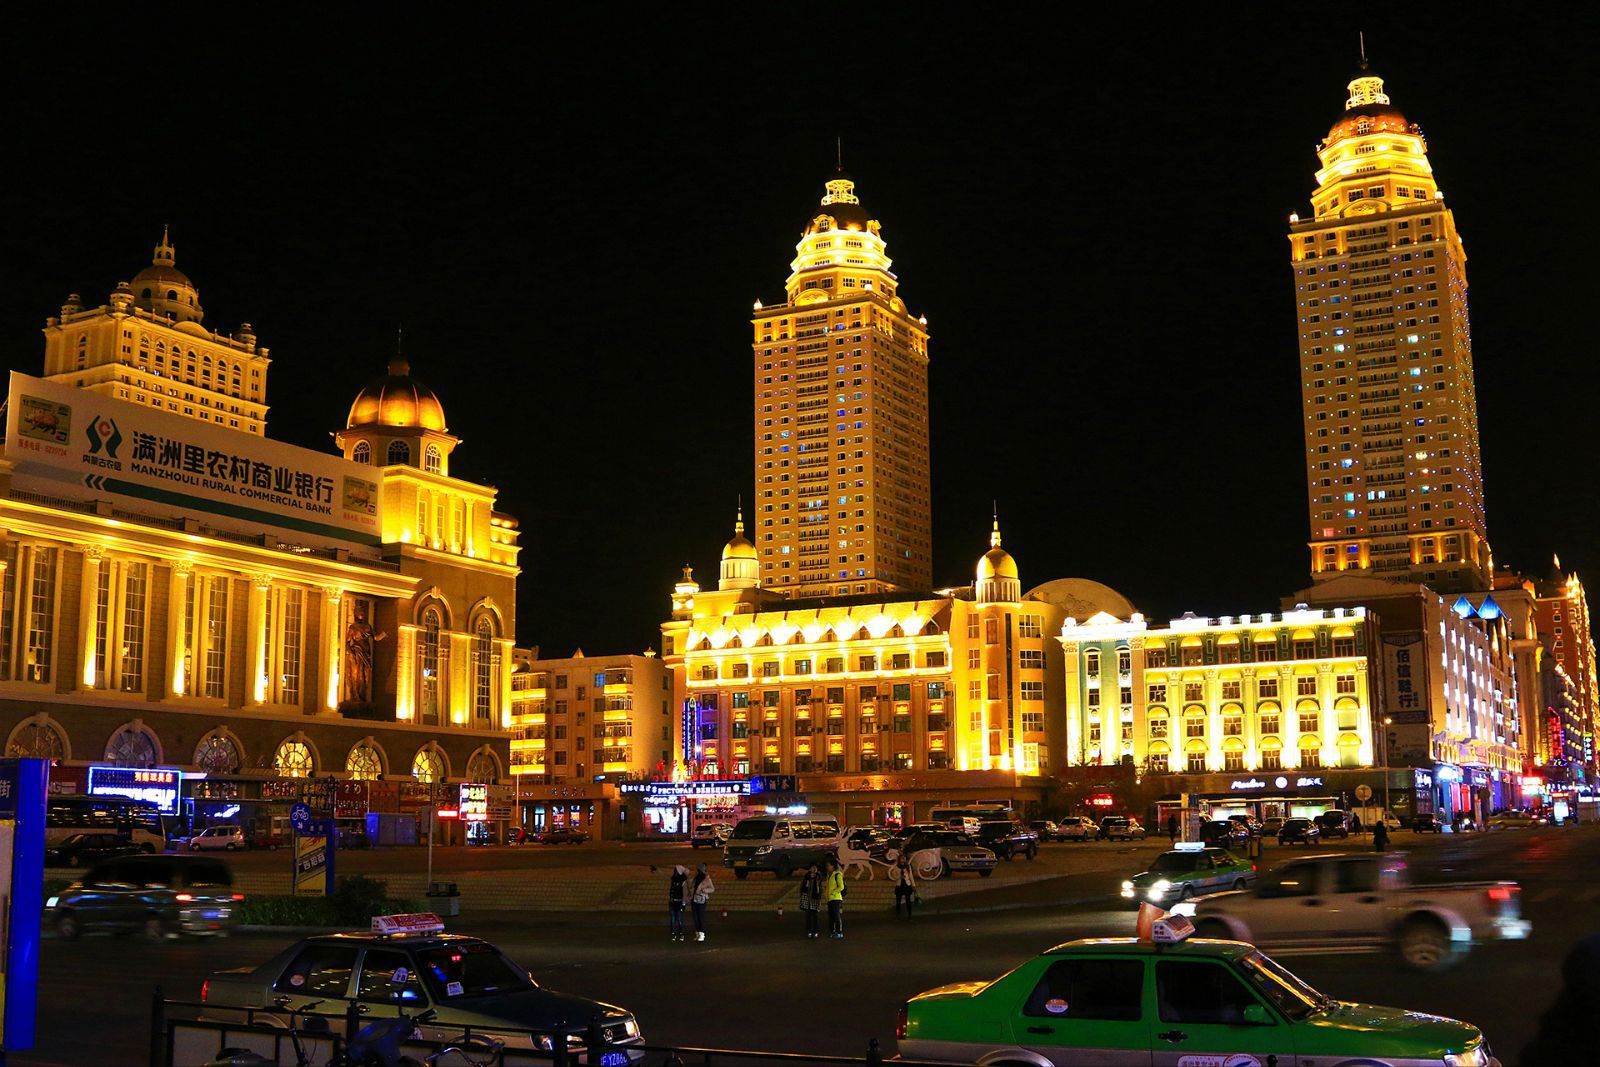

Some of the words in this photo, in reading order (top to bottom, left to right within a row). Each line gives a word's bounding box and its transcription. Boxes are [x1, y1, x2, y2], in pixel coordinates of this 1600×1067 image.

[131, 431, 334, 503] 满洲里农村商业银行
[131, 462, 199, 486] MANZHOULI
[202, 479, 237, 494] RURAL
[239, 487, 303, 509] COMMERCIAL
[305, 502, 332, 516] BANK
[657, 786, 694, 794] РЕСТОРАН
